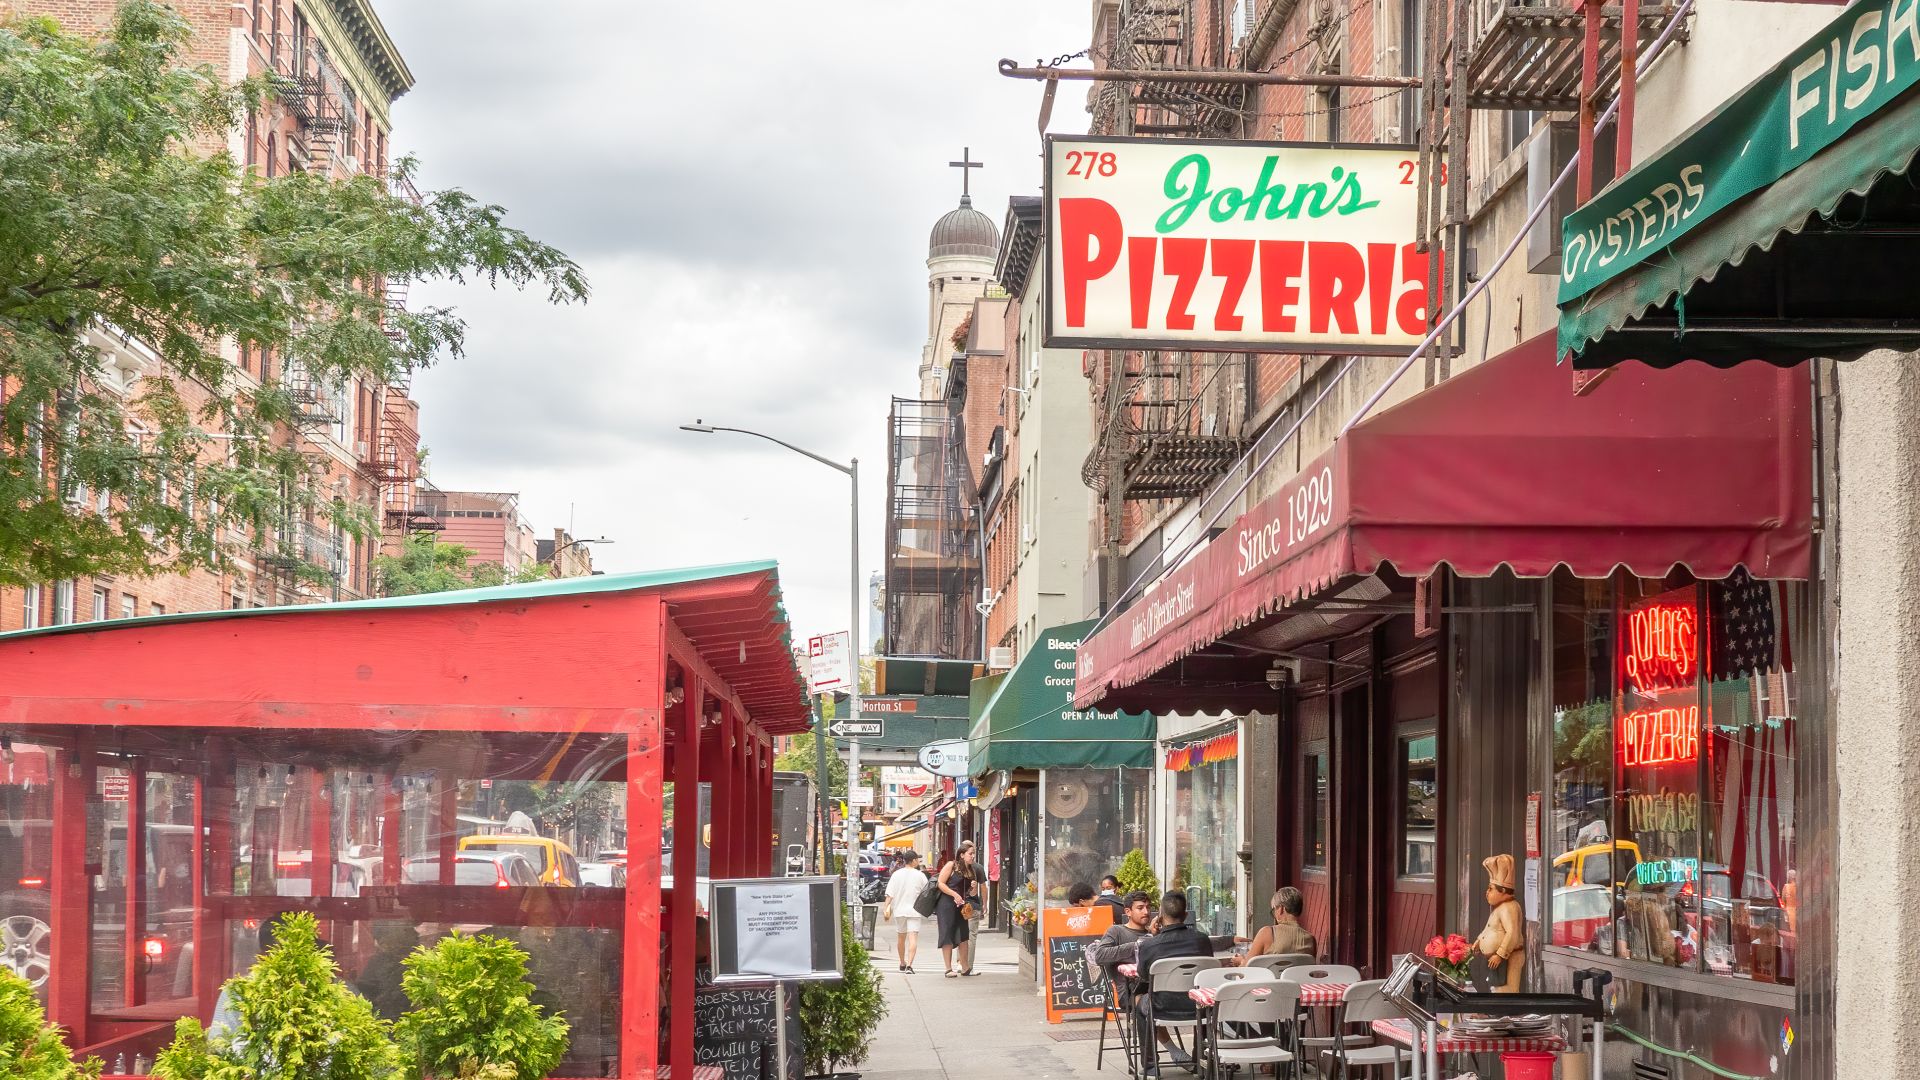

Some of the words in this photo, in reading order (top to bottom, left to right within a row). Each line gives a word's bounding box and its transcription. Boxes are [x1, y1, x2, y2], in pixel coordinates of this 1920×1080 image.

[1065, 150, 1117, 179] 278
[1155, 153, 1381, 234] John's
[1563, 164, 1705, 284] OYSTERS
[1238, 518, 1281, 577] Since
[1287, 466, 1333, 547] 1929
[1131, 612, 1146, 650] John's
[1153, 591, 1177, 635] Bleecker
[1176, 574, 1194, 618] Street
[1054, 659, 1076, 670] Gour
[1045, 675, 1076, 686] Grocer
[863, 702, 891, 712] Morton
[894, 702, 902, 712] St
[1061, 711, 1082, 721] OPEN
[1085, 711, 1095, 720] 24
[835, 724, 853, 732] ONE
[860, 724, 878, 732] WAY
[1051, 938, 1078, 954] LIFE
[1053, 956, 1085, 971] Short
[1052, 972, 1075, 989] Eat
[694, 990, 740, 1006] RDERS
[742, 989, 785, 1002] PLACE
[732, 1002, 769, 1017] MUST
[705, 1020, 745, 1037] TAKEN
[693, 1044, 720, 1063] YOU
